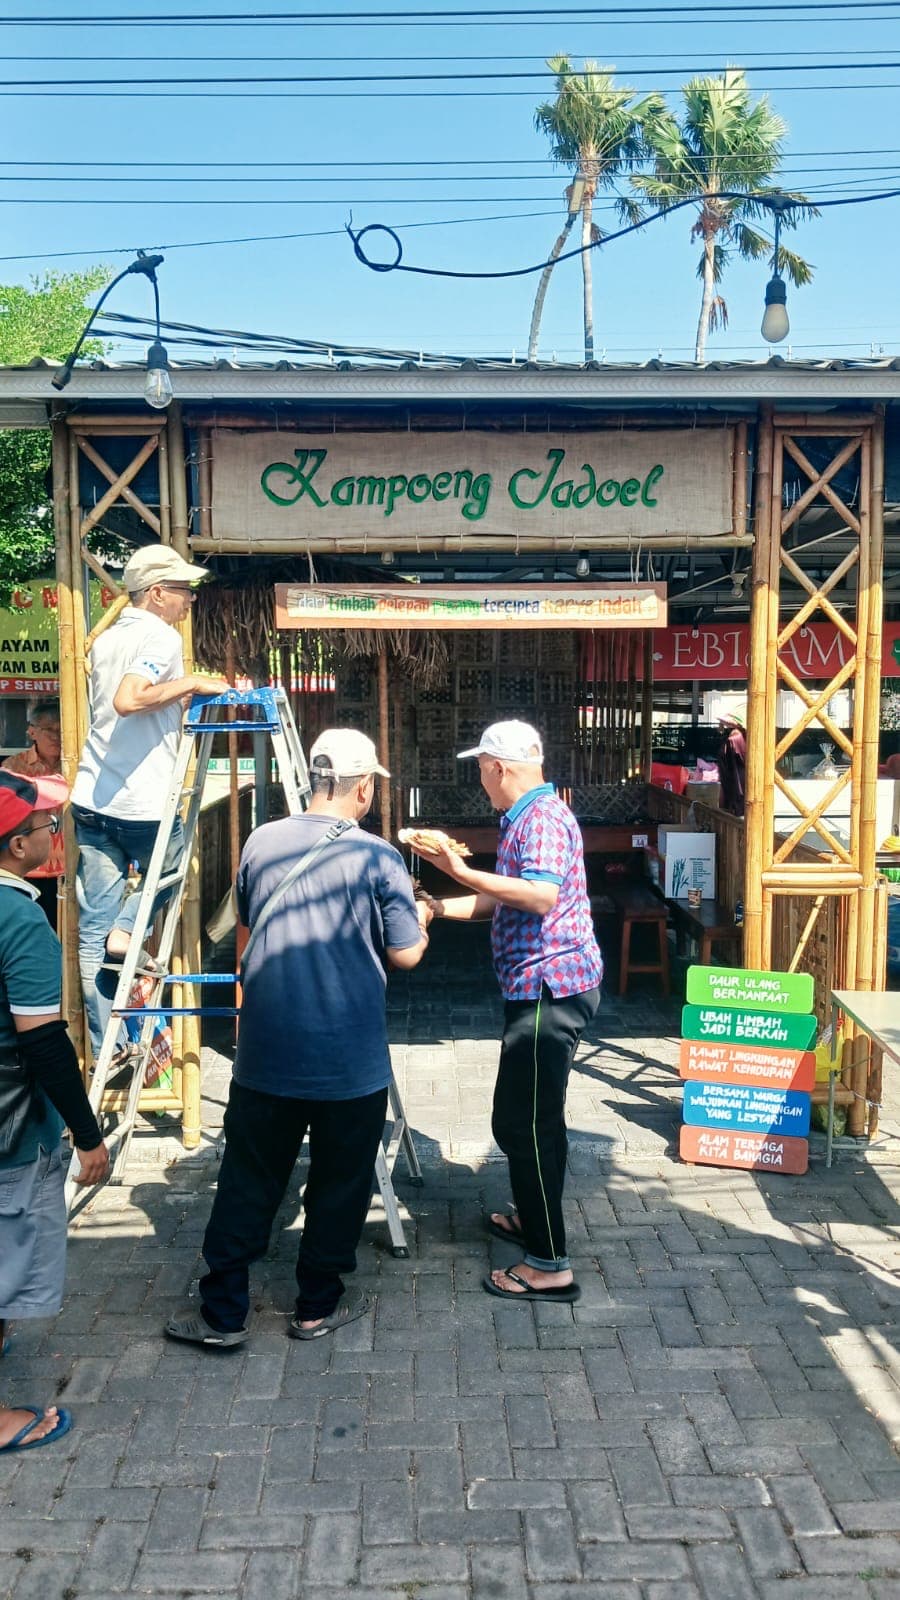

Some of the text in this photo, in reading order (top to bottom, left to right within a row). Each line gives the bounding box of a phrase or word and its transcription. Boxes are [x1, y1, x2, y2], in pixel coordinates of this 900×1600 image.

[260, 448, 664, 521] Kampoeng Jadoel
[484, 598, 540, 615] tercipta
[1, 640, 49, 652] AYAM
[0, 661, 26, 673] AM
[708, 974, 781, 991] DAUR ULANG
[713, 987, 790, 1004] BERMANFAAT
[700, 1010, 782, 1029] UBAH LIMBAH
[700, 1022, 788, 1041] JADI BERKAH
[689, 1046, 796, 1069] RAWAT LINGKUNGAN
[688, 1059, 793, 1079] RAWAT KEHIDUPAN
[703, 1086, 787, 1103] BERSAMA WARGA
[705, 1107, 783, 1126] YANG LESTARI
[744, 1101, 803, 1116] LINGKUNGAN
[698, 1133, 784, 1153] ALAM TERJAGA
[699, 1146, 783, 1165] KITA BAHAGIA
